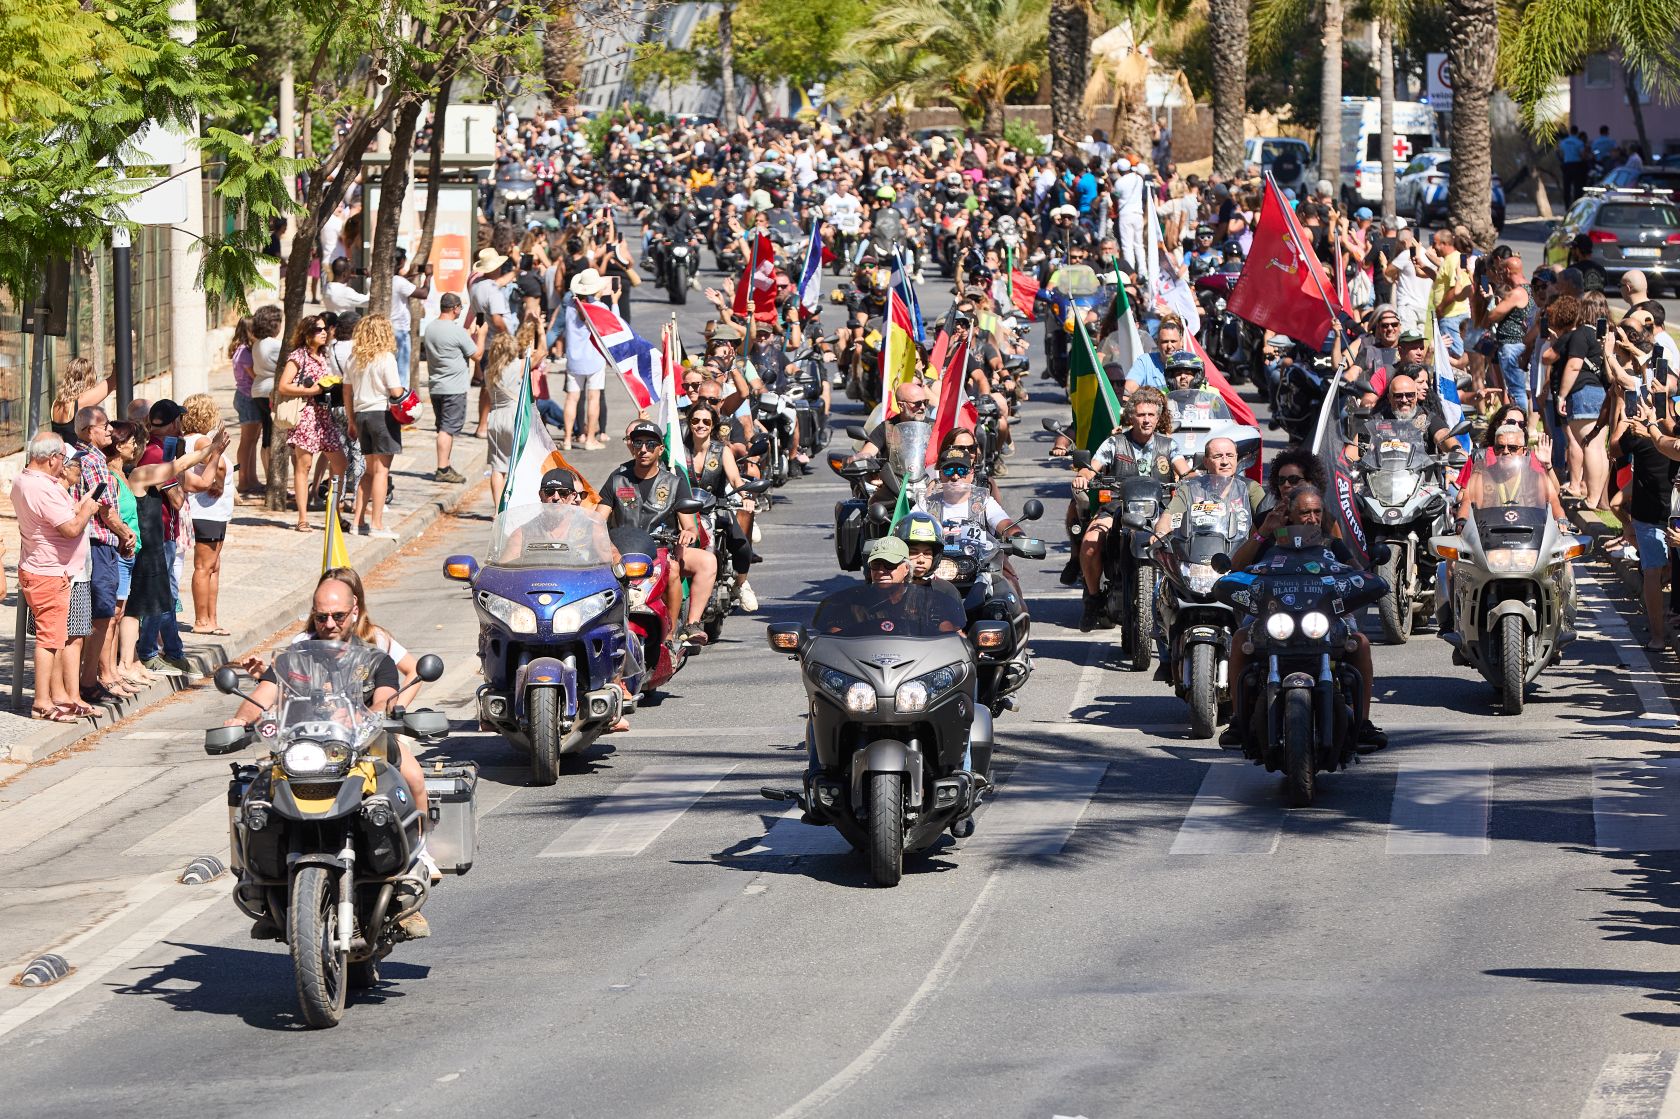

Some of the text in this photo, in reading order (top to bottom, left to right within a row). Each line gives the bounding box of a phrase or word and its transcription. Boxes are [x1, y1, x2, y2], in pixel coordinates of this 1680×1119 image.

[966, 527, 982, 541] 42
[1273, 586, 1324, 596] BLACK LION
